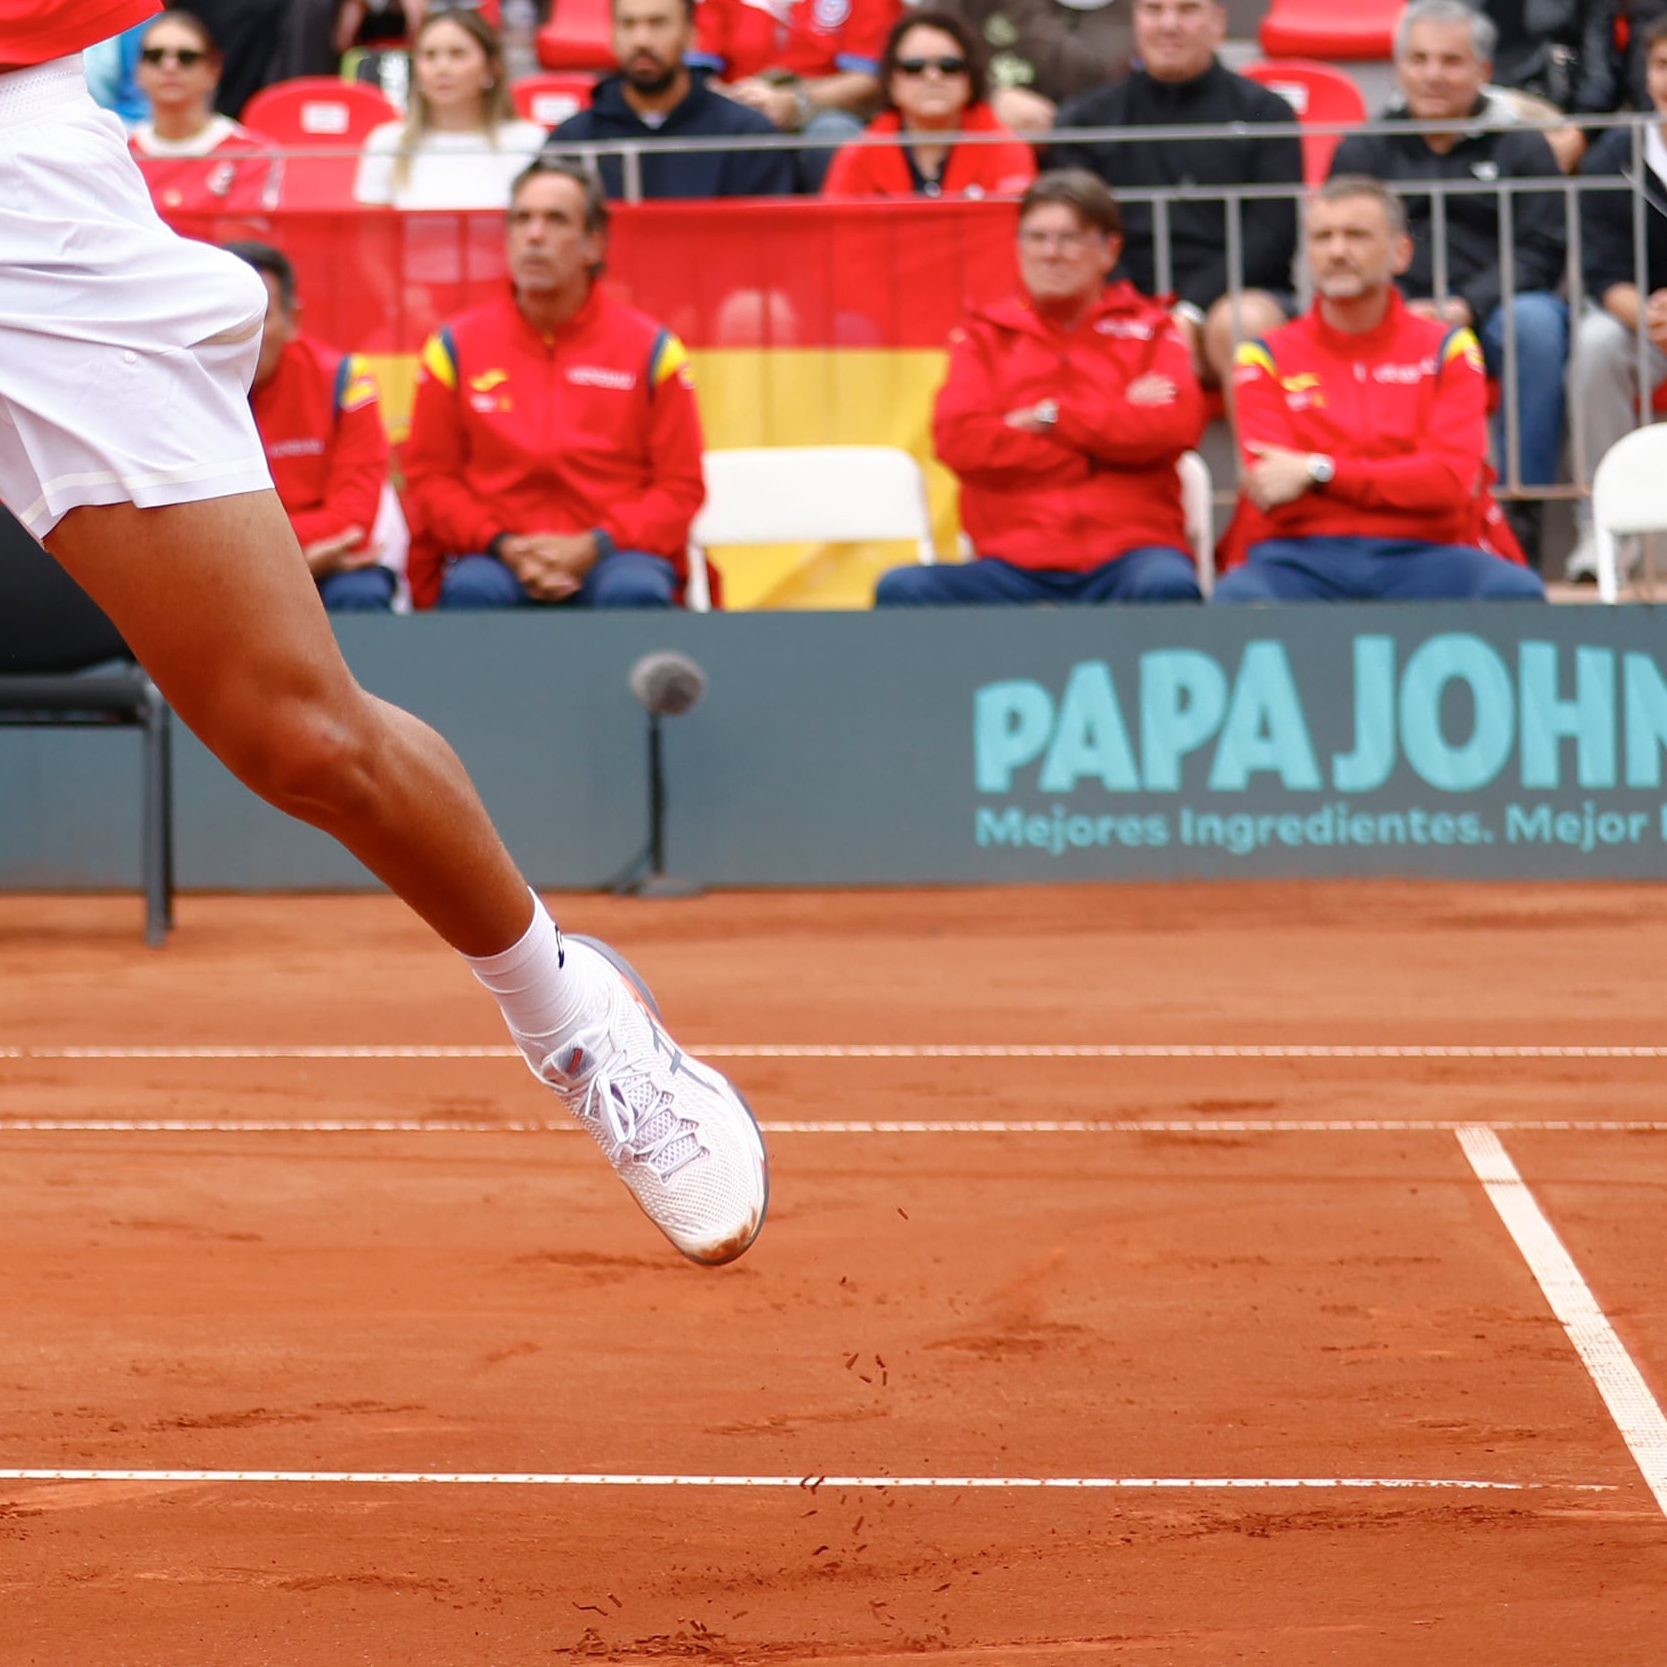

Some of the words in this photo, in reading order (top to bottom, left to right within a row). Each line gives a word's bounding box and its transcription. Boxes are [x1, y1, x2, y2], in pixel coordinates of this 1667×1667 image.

[974, 638, 1324, 793] PAPA
[975, 804, 1168, 856] Mejores
[1180, 803, 1495, 855] Ingredientes.
[1505, 799, 1649, 854] Mejor
